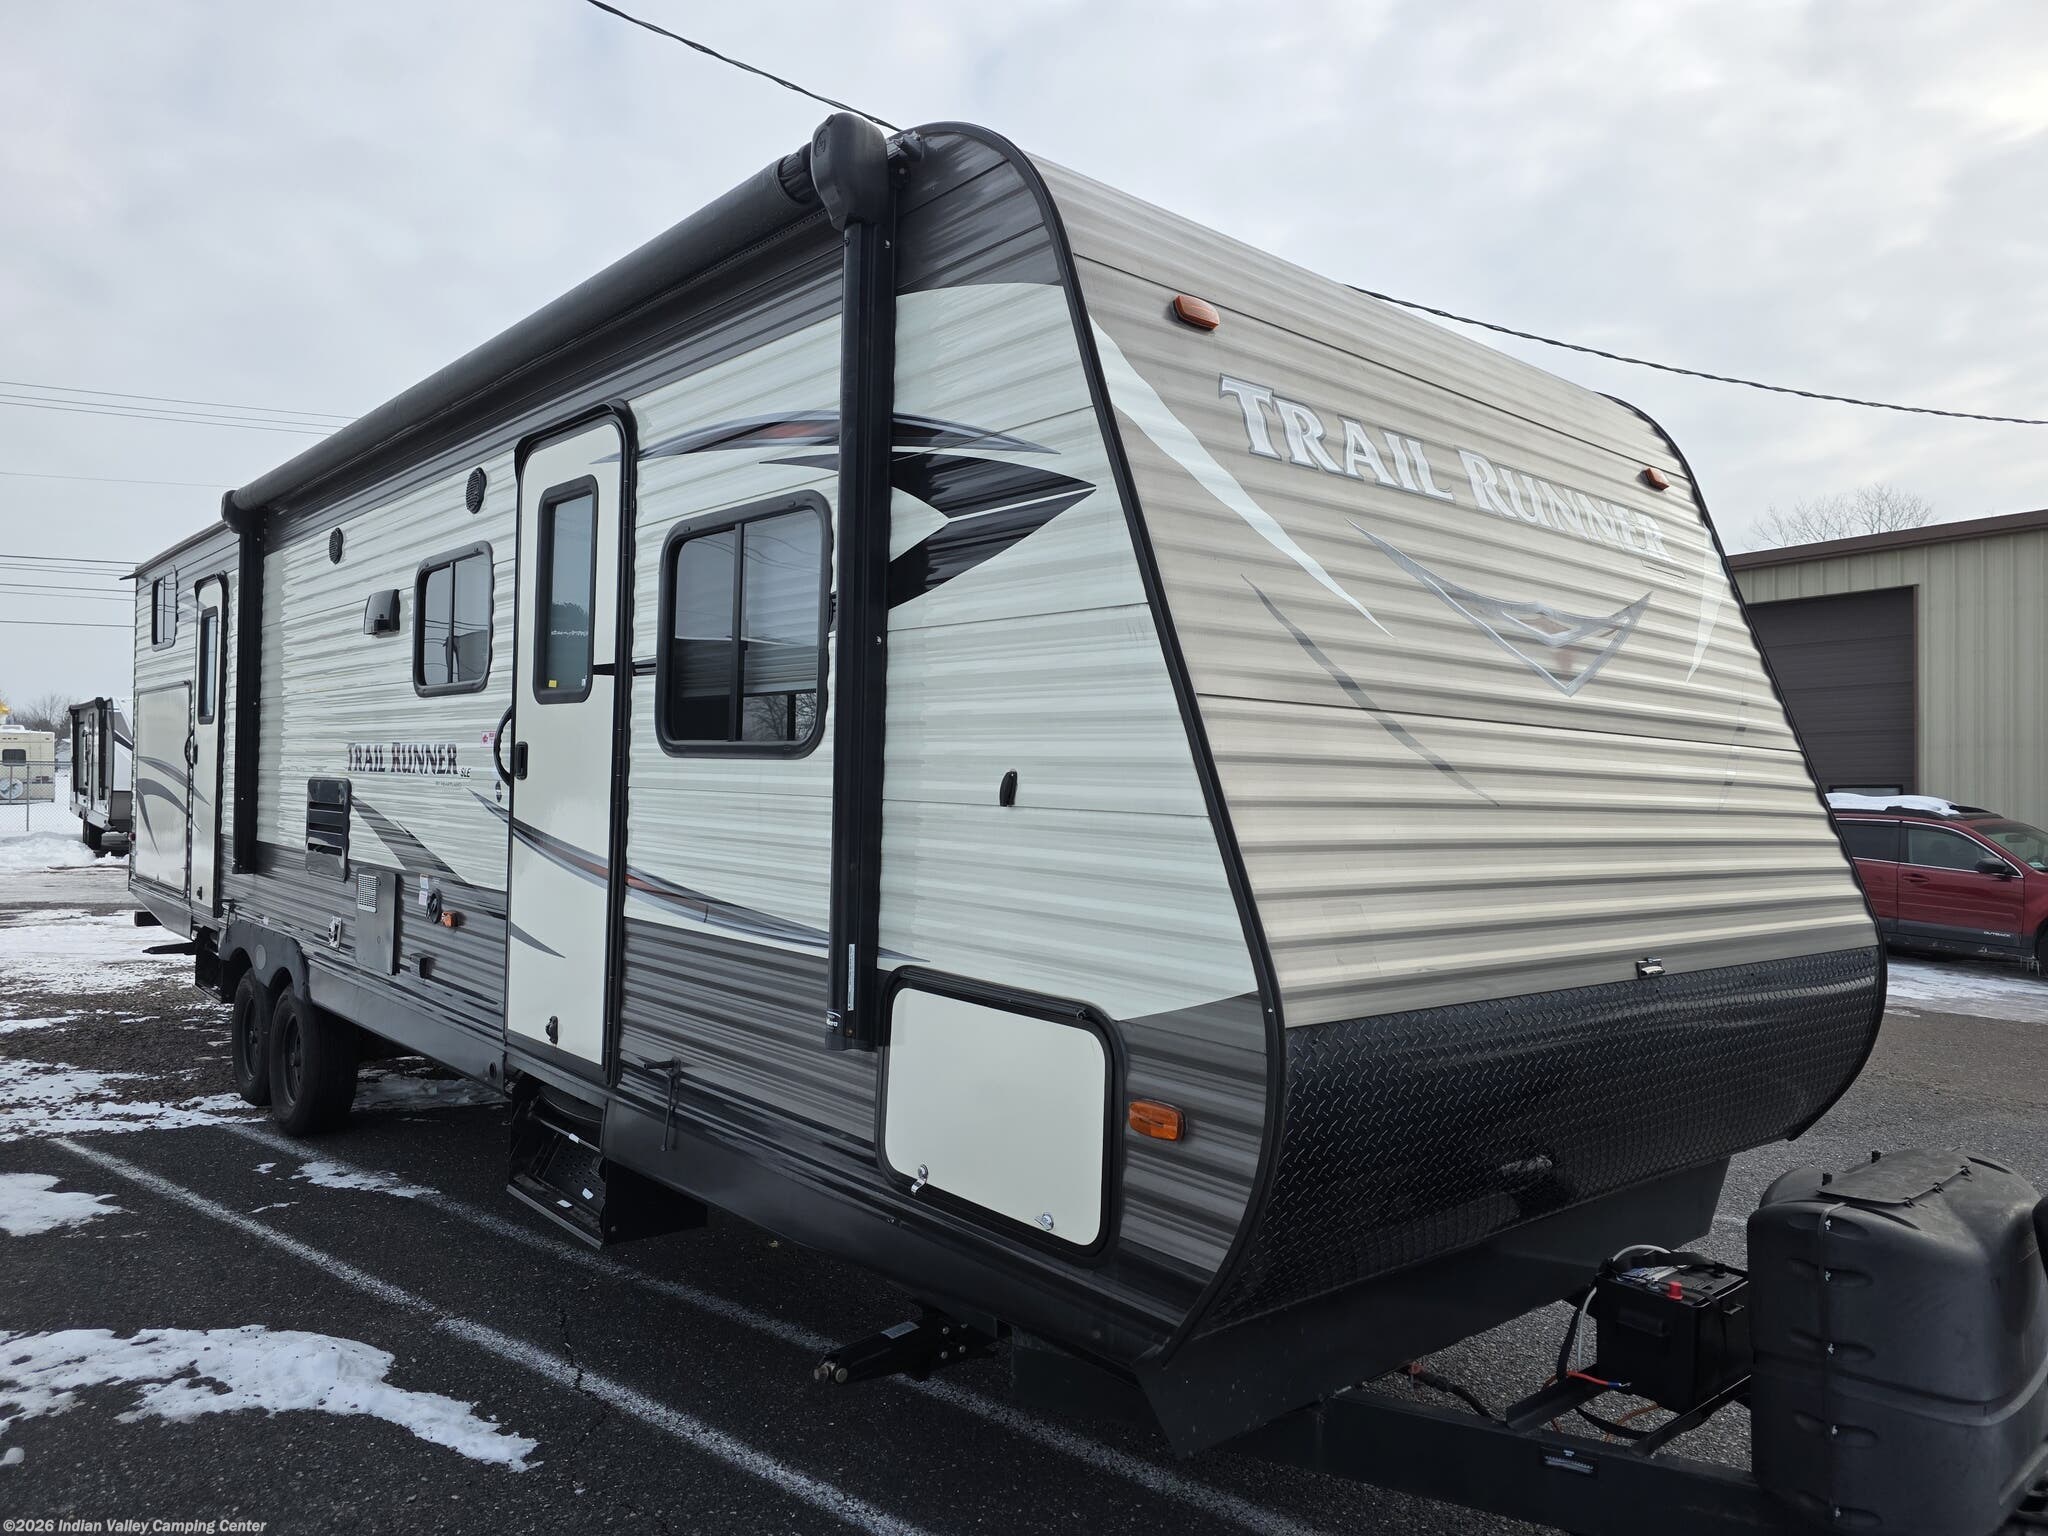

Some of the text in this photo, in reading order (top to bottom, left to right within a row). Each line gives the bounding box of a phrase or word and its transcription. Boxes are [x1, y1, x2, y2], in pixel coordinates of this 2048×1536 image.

[1219, 373, 1676, 563] TRAIL RUNNER
[347, 742, 386, 773] TRAIL
[390, 741, 459, 775] RUNNER
